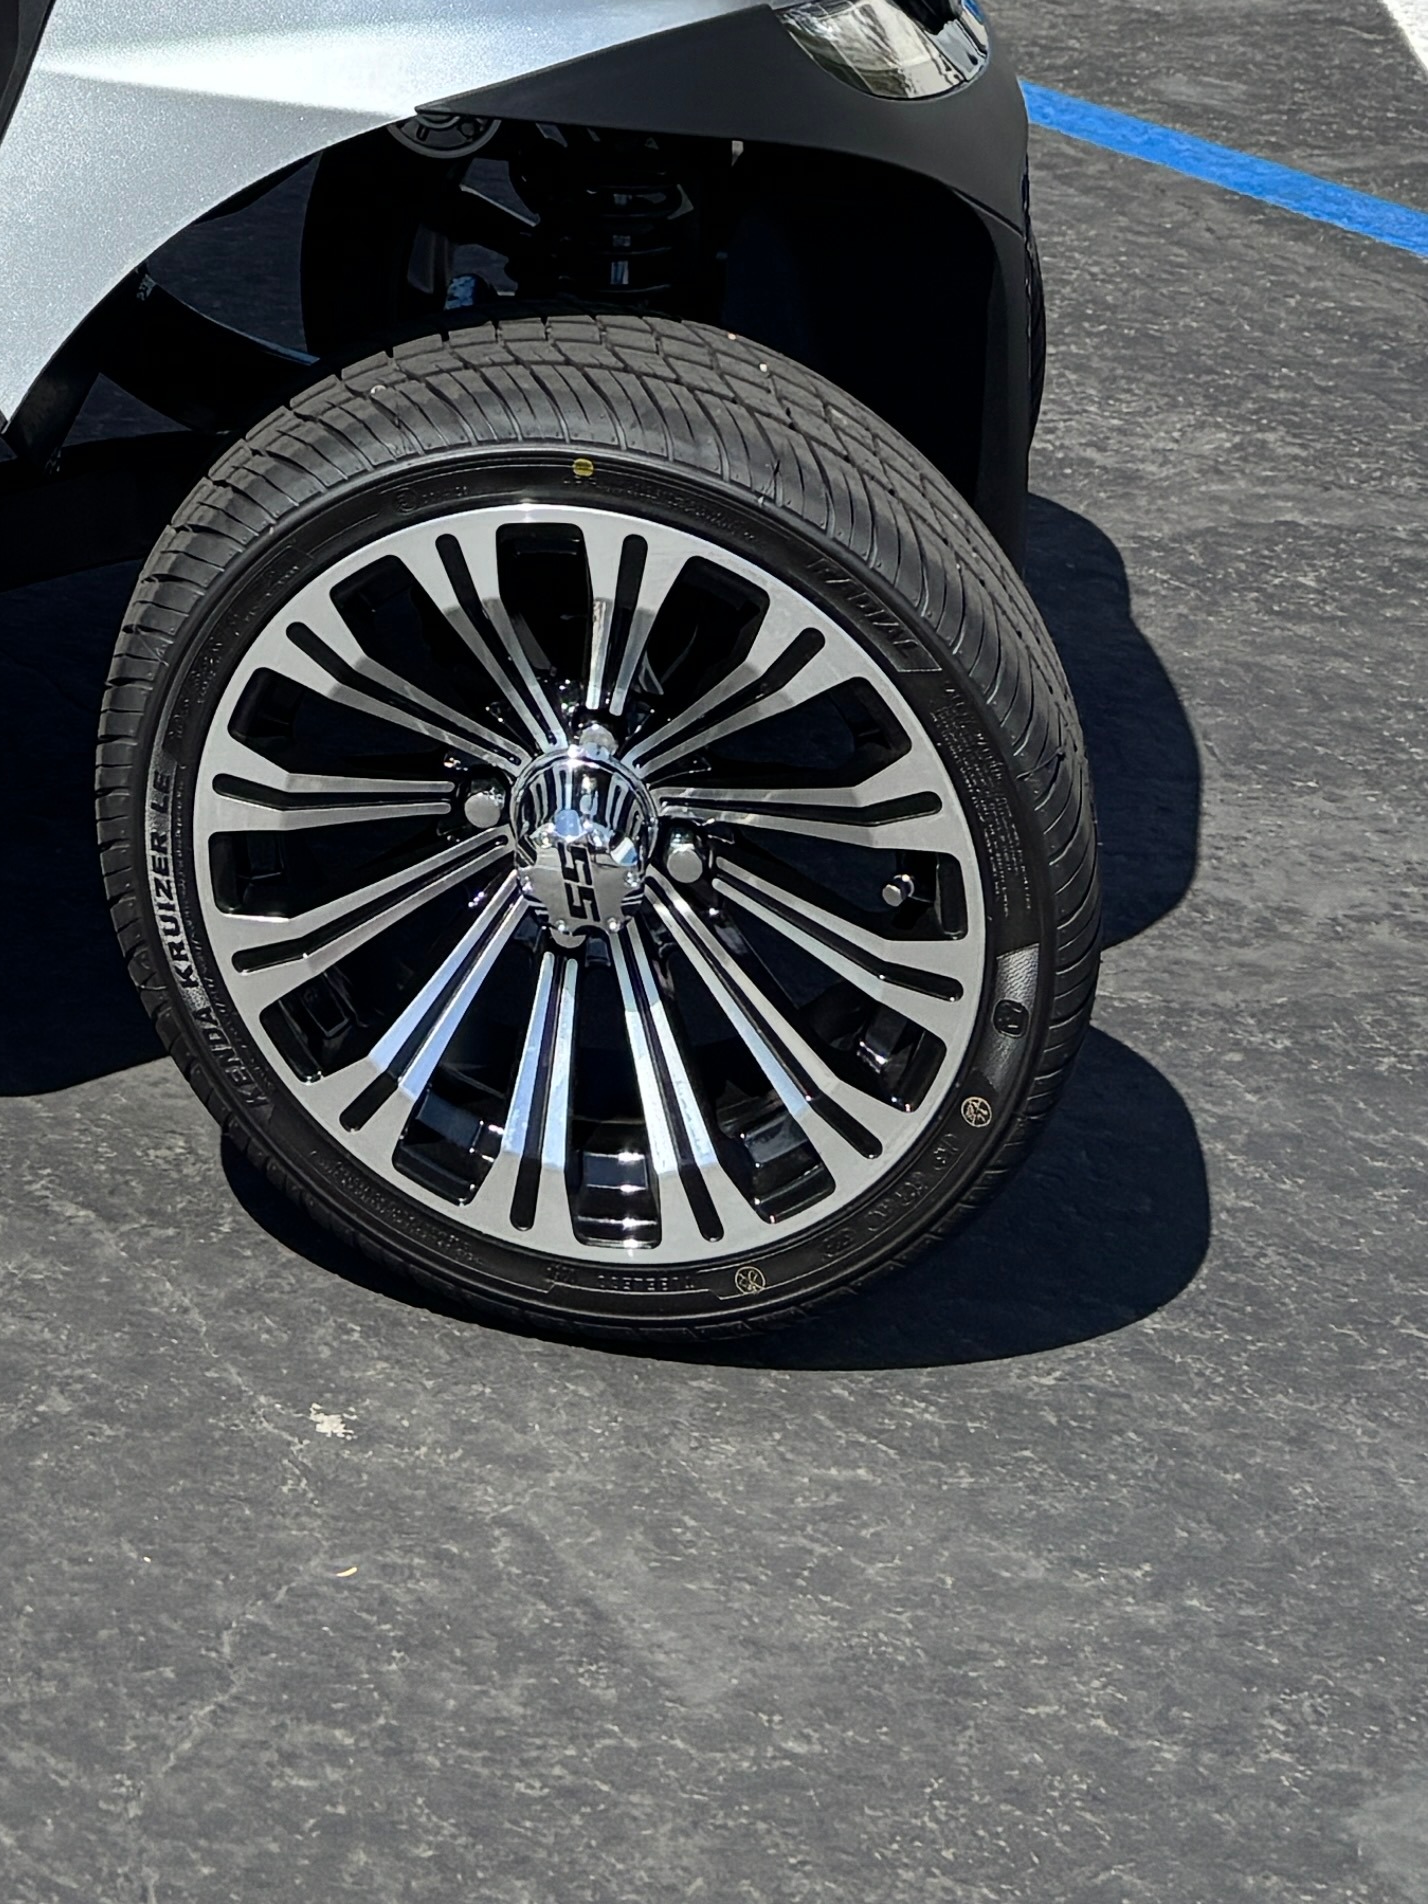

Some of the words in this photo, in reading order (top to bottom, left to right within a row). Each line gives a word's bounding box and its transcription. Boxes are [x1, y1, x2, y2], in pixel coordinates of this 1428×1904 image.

[149, 769, 172, 815] LE
[149, 829, 200, 989] KRUIZER
[195, 1005, 272, 1108] KENDA
